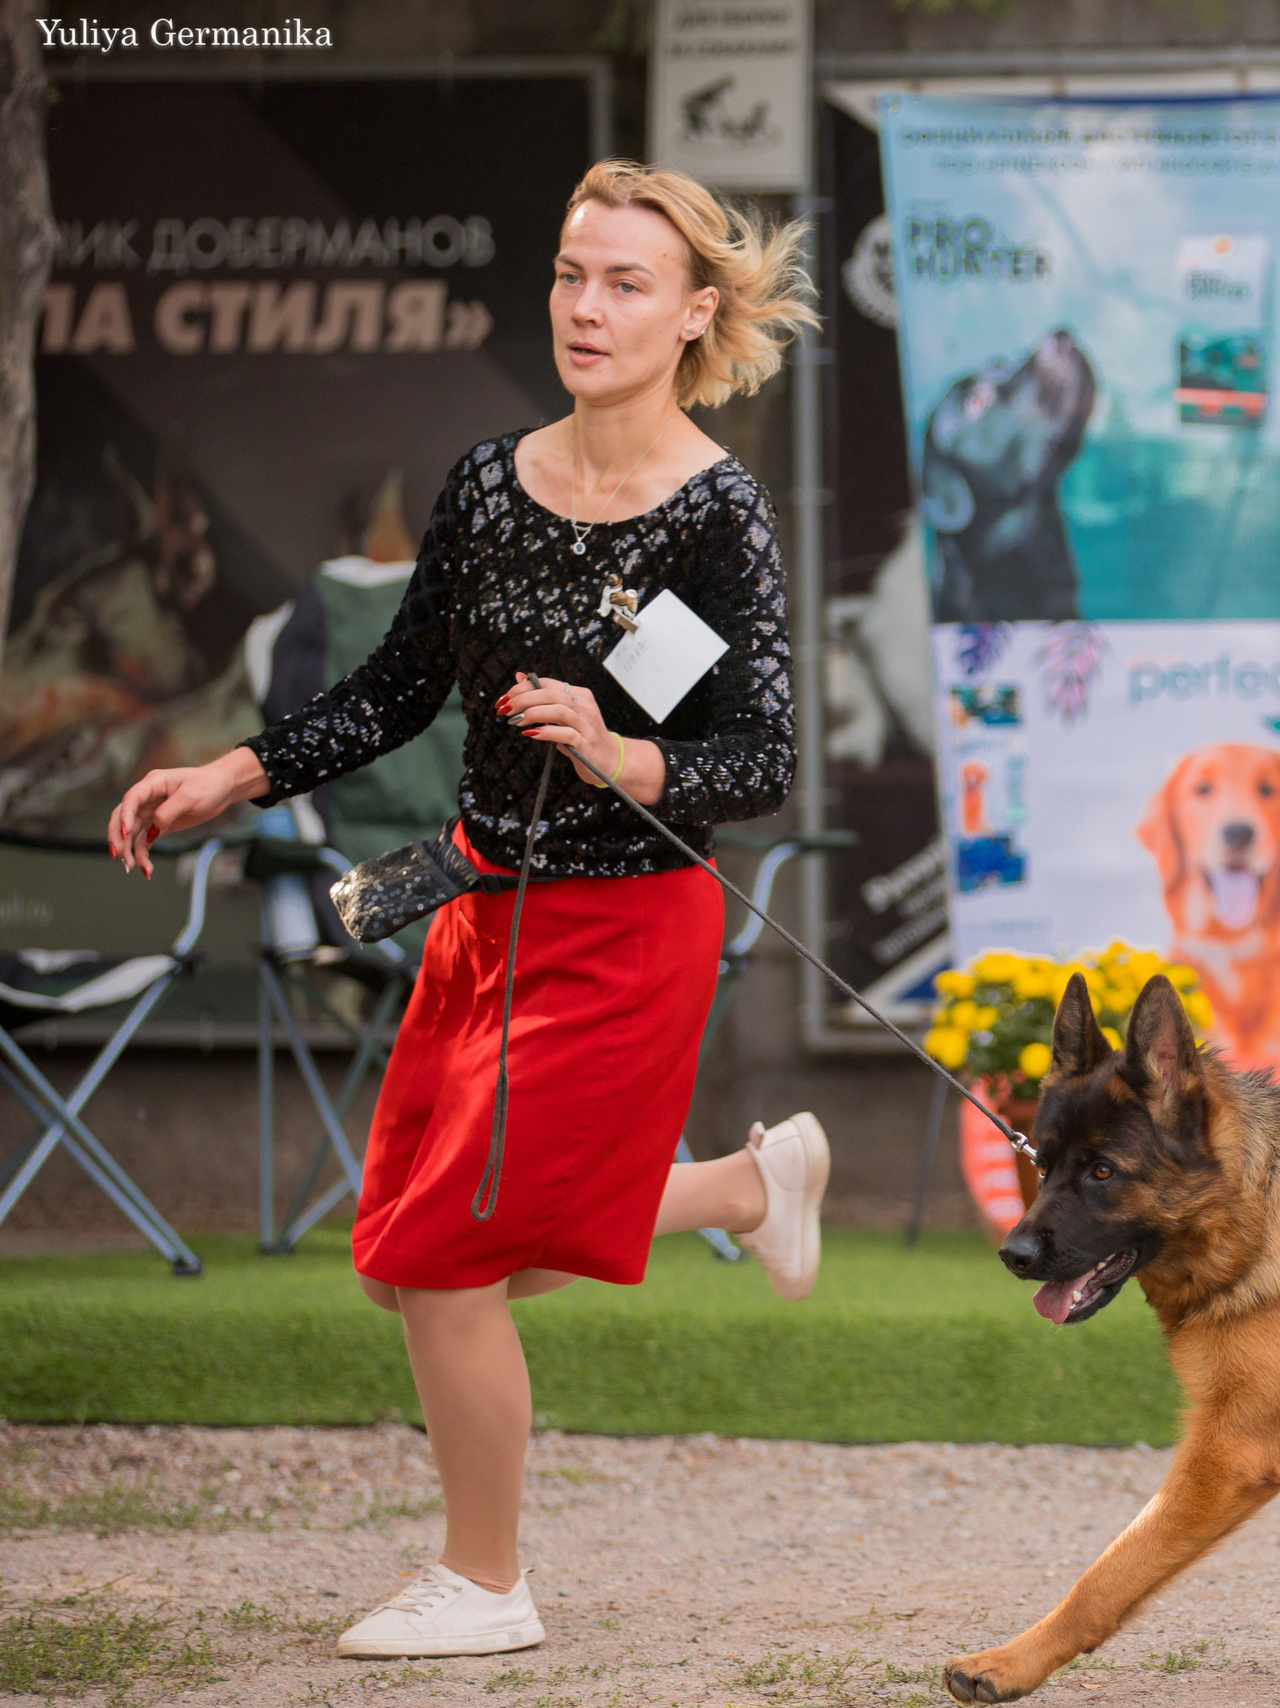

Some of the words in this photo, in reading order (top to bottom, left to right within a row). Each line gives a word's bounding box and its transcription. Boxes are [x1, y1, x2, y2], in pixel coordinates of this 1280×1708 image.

[147, 214, 497, 276] ДОБЕРМАНОВ
[908, 216, 990, 250] PRO
[913, 247, 1053, 281] HUNTER
